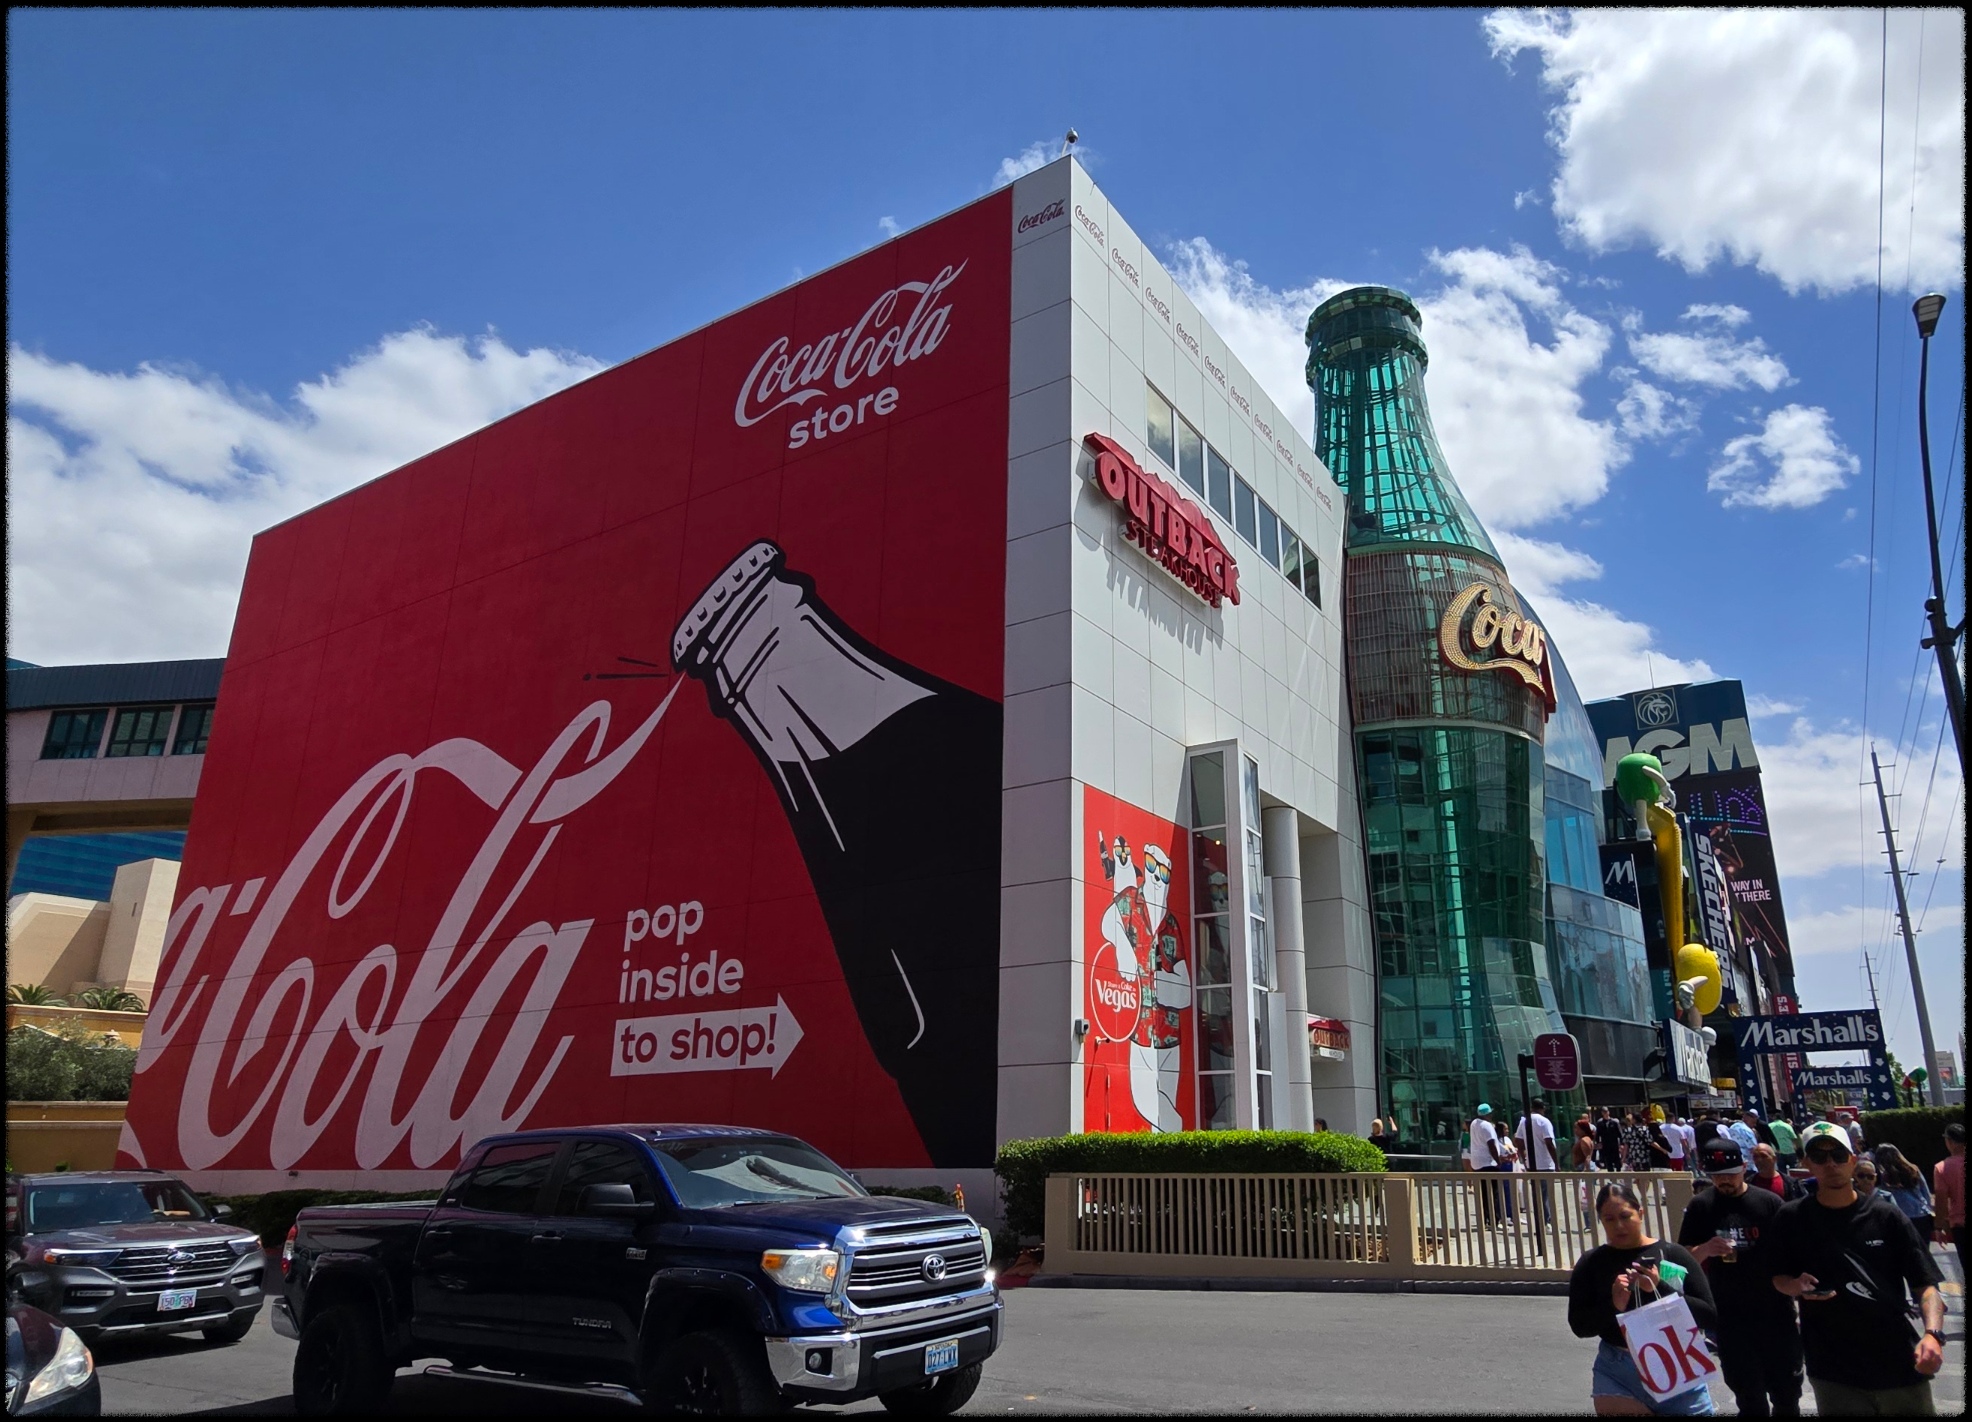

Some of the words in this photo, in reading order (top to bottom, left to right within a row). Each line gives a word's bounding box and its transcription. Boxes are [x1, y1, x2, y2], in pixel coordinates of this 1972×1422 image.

[1018, 200, 1065, 233] Coca-Cola
[1075, 205, 1104, 248] Coca-Cola
[735, 257, 969, 427] Coca-Cola
[788, 386, 899, 449] store
[1095, 451, 1240, 606] OUTBACK
[1742, 890, 1771, 902] THERE
[1752, 879, 1763, 890] IN
[623, 900, 704, 952] pop
[1695, 833, 1734, 991] SKECHERS
[619, 950, 744, 1003] inside
[1095, 978, 1136, 1013] Vegas
[621, 1025, 658, 1064] to
[670, 1013, 777, 1066] shop!
[1313, 1029, 1350, 1049] OUTBACK
[1741, 1014, 1879, 1047] Marshalls
[1796, 1070, 1872, 1086] Marshalls
